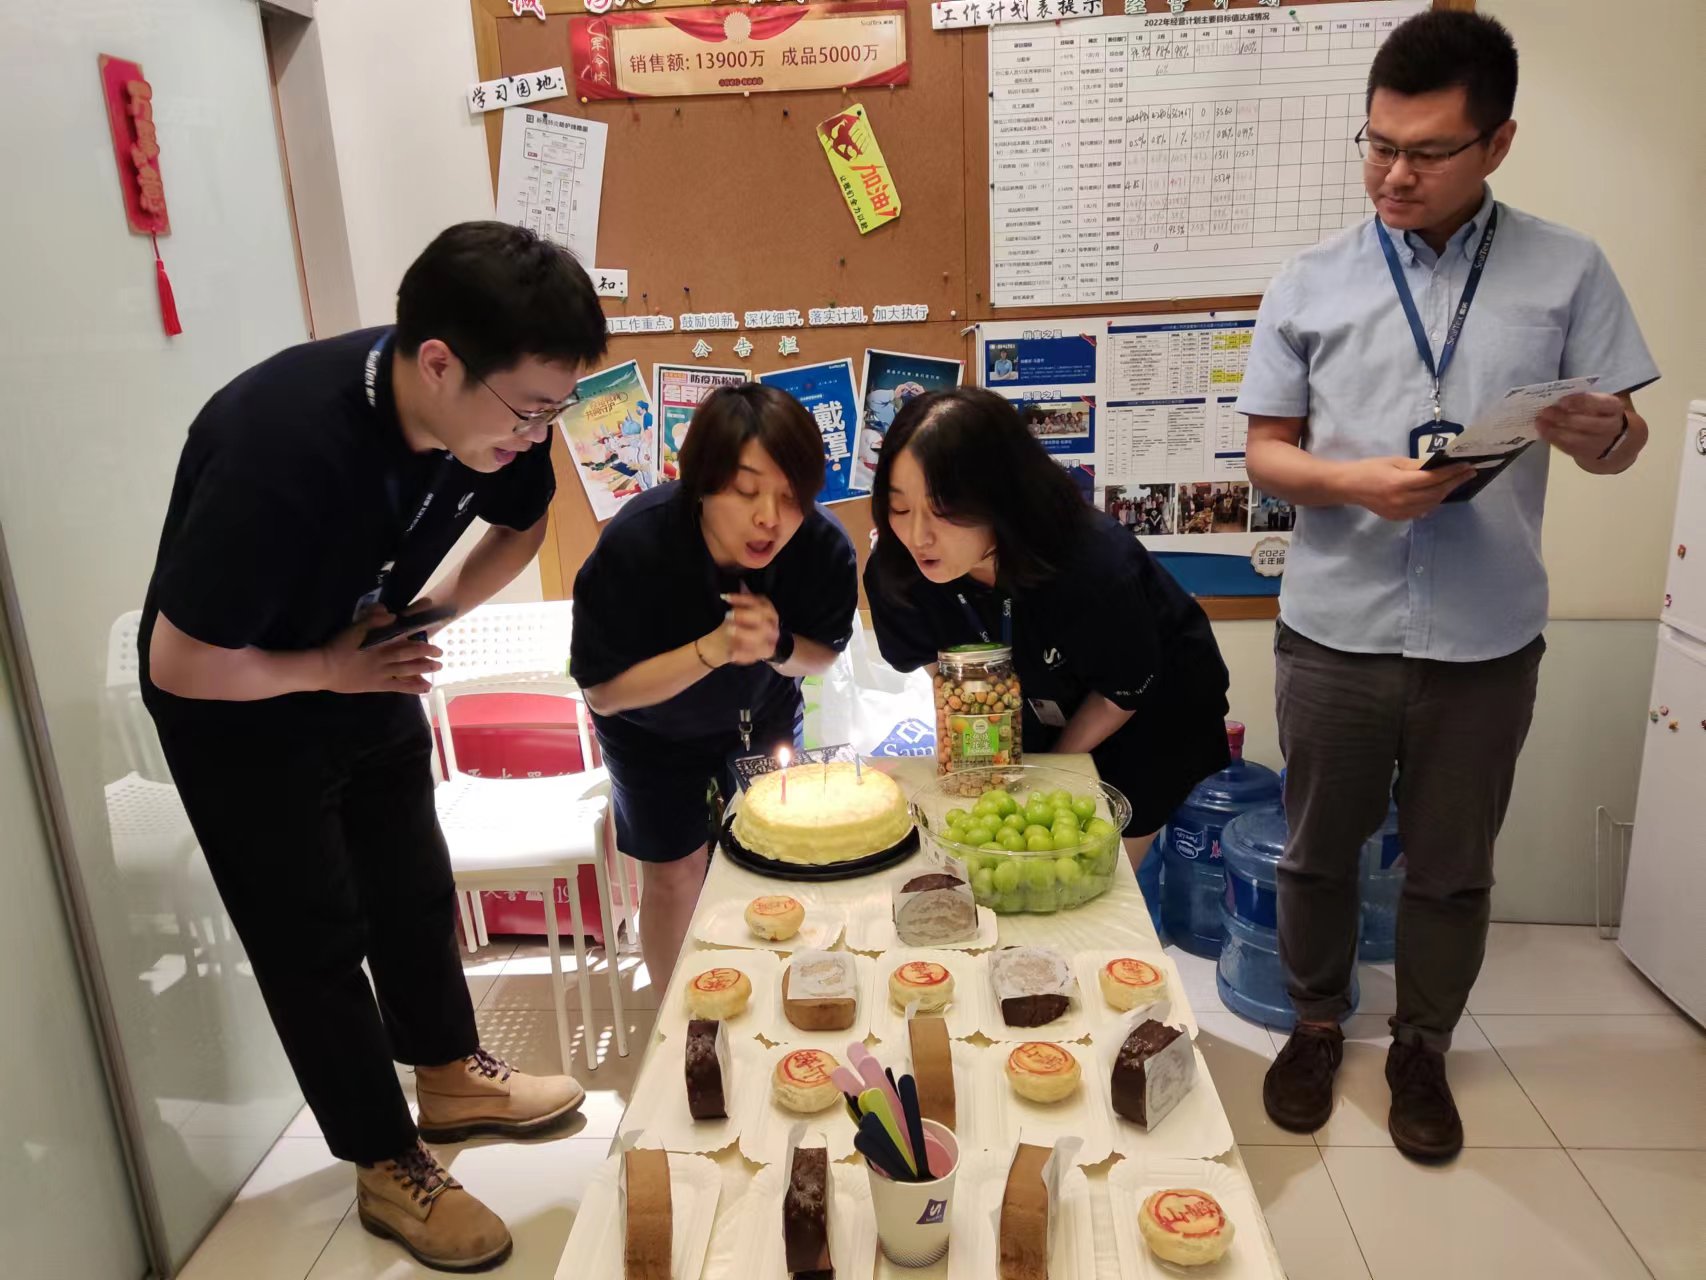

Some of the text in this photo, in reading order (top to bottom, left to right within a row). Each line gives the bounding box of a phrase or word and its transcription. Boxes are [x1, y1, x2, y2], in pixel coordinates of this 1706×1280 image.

[940, 0, 1100, 25] 工作计划表提示
[1144, 12, 1270, 27] 2022年经营计划主要目标值达成情况
[781, 44, 880, 67] 成品5000万
[594, 274, 623, 292] 知:
[746, 310, 803, 327] 深化细节,
[811, 307, 867, 323] 落实计划,
[874, 305, 928, 321] 加大执行
[1259, 549, 1286, 557] 2022
